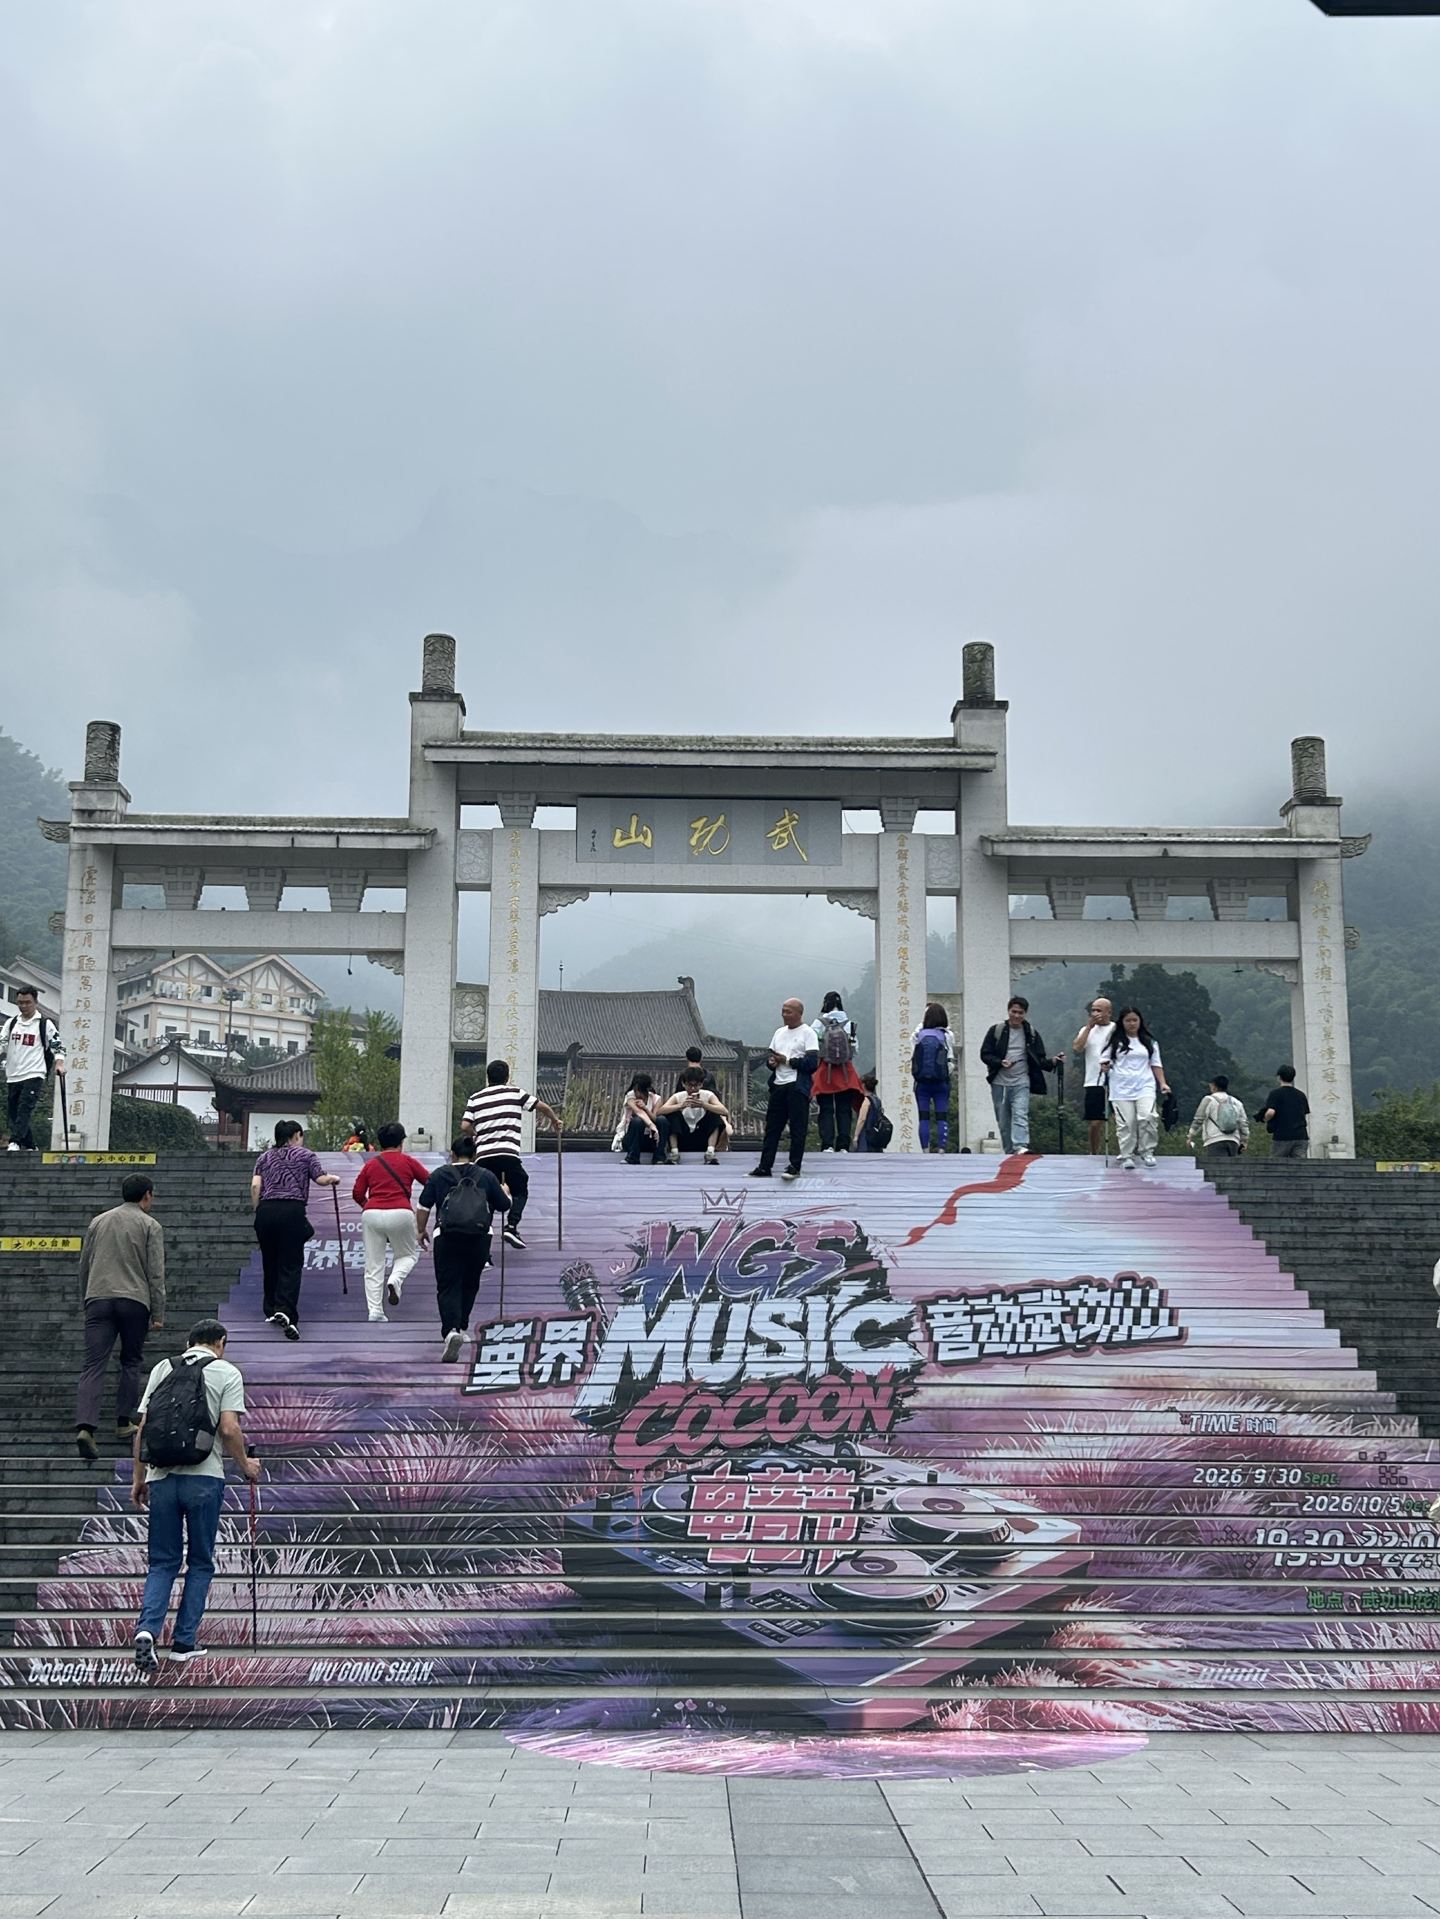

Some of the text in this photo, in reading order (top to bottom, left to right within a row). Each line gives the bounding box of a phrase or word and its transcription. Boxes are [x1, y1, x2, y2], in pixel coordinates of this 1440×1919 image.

[611, 807, 808, 862] 武功山
[107, 1155, 147, 1163] 小心台阶
[26, 1239, 71, 1247] 小心台阶
[628, 1219, 858, 1302] WGS
[572, 1283, 920, 1415] MUSIC
[925, 1281, 1182, 1361] 音动武功山
[613, 1365, 897, 1456] COCOON
[1189, 1414, 1276, 1434] TIME 时间
[687, 1460, 861, 1575] 电音节
[308, 1661, 434, 1681] WU GONG SHAN
